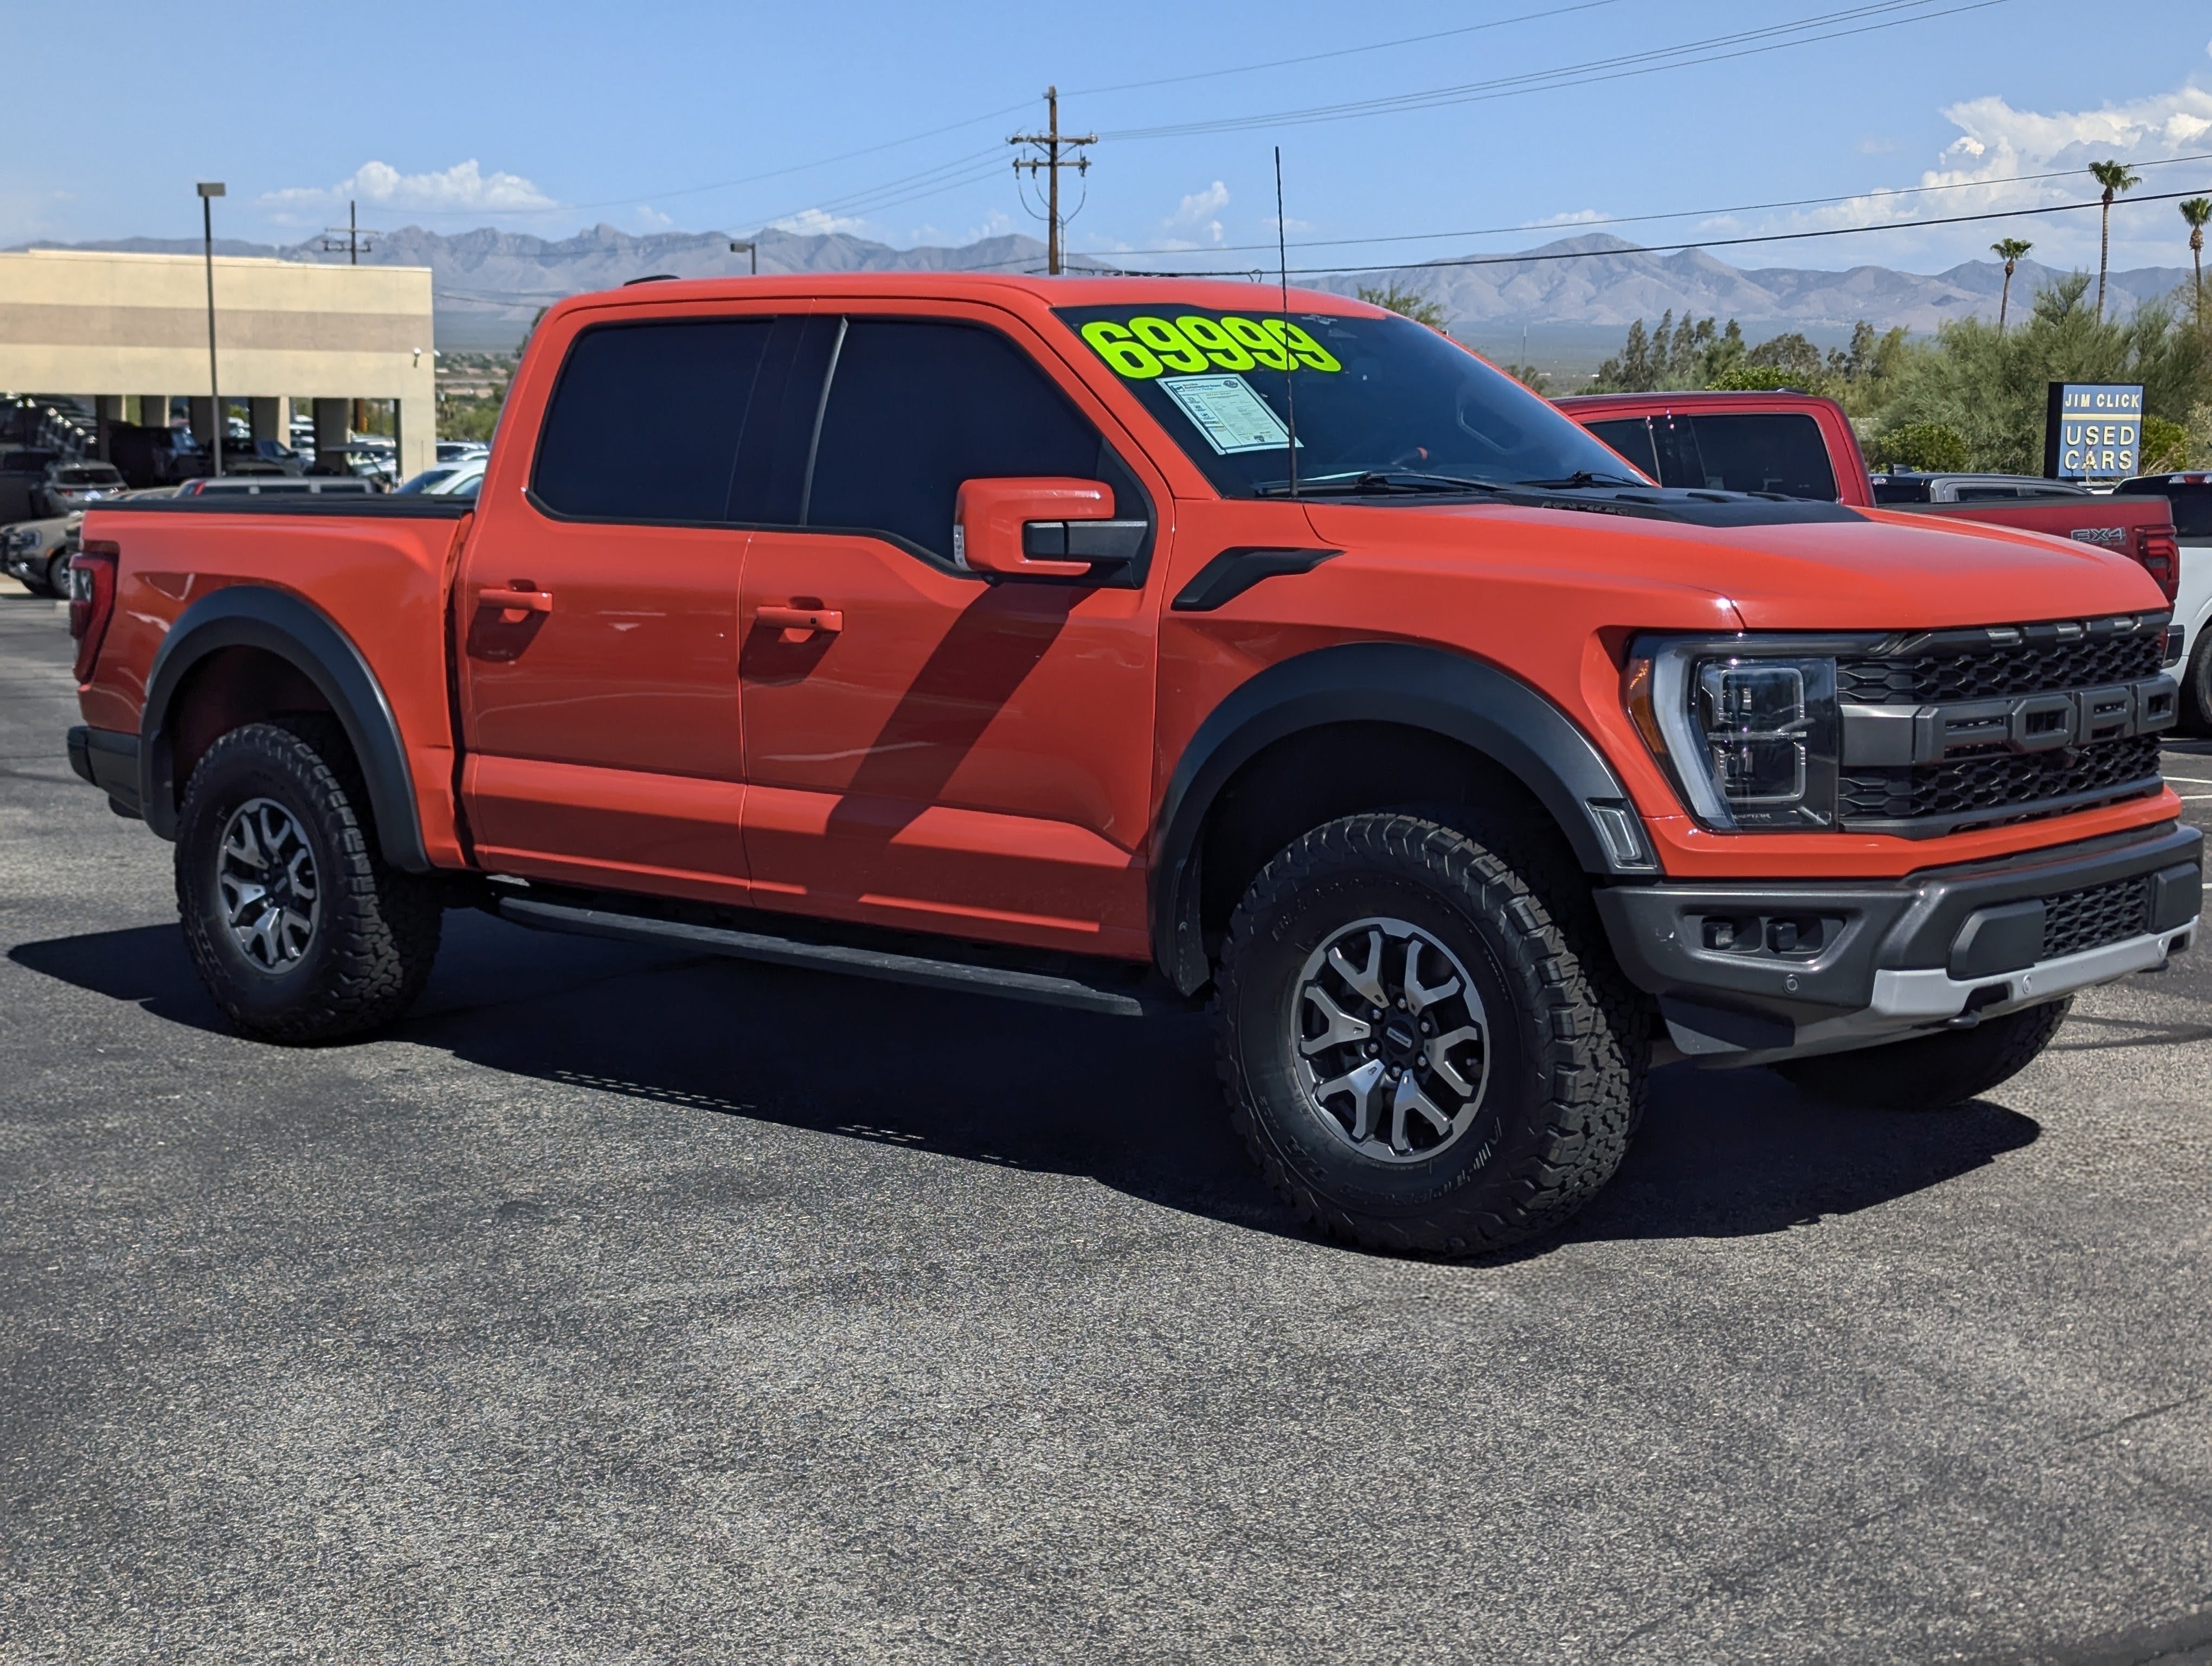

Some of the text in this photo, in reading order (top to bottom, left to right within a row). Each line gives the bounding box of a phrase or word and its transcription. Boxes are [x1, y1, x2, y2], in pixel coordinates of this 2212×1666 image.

[1081, 316, 1341, 379] 69999
[2065, 393, 2139, 408] JIM CLICK
[2066, 426, 2135, 446] USED
[2064, 450, 2132, 470] CARS
[1915, 674, 2179, 765] FORD
